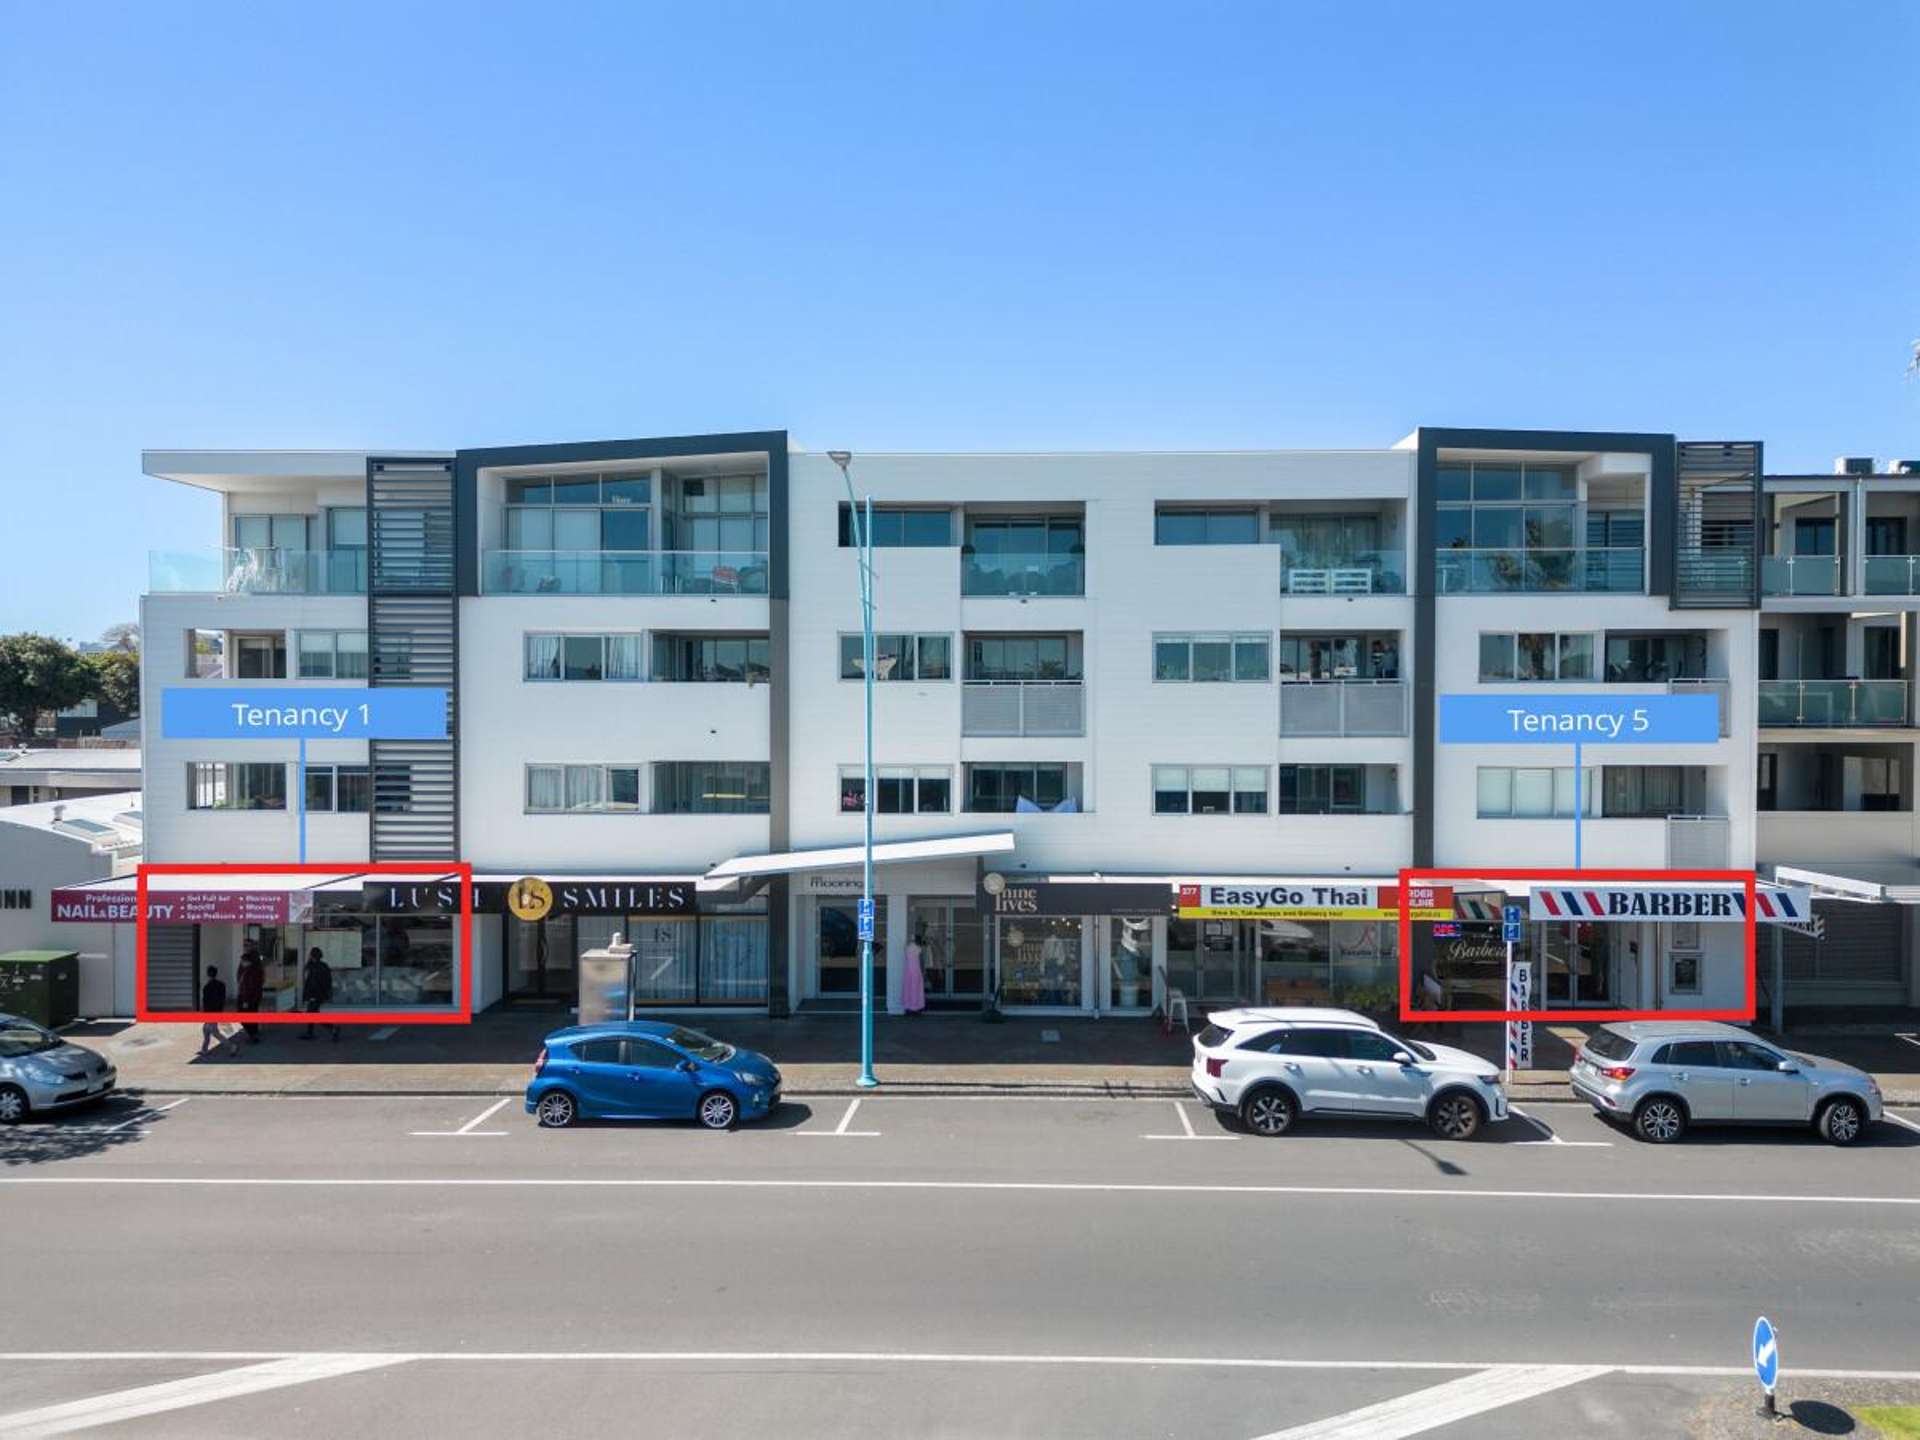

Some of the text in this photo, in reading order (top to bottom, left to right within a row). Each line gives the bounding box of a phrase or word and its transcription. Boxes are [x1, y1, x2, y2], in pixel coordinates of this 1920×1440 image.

[563, 887, 685, 909] SMILES
[995, 893, 1038, 912] lives
[1210, 887, 1368, 908] EasyGo Thai
[1409, 889, 1433, 898] RDER
[1608, 892, 1732, 916] BARBER
